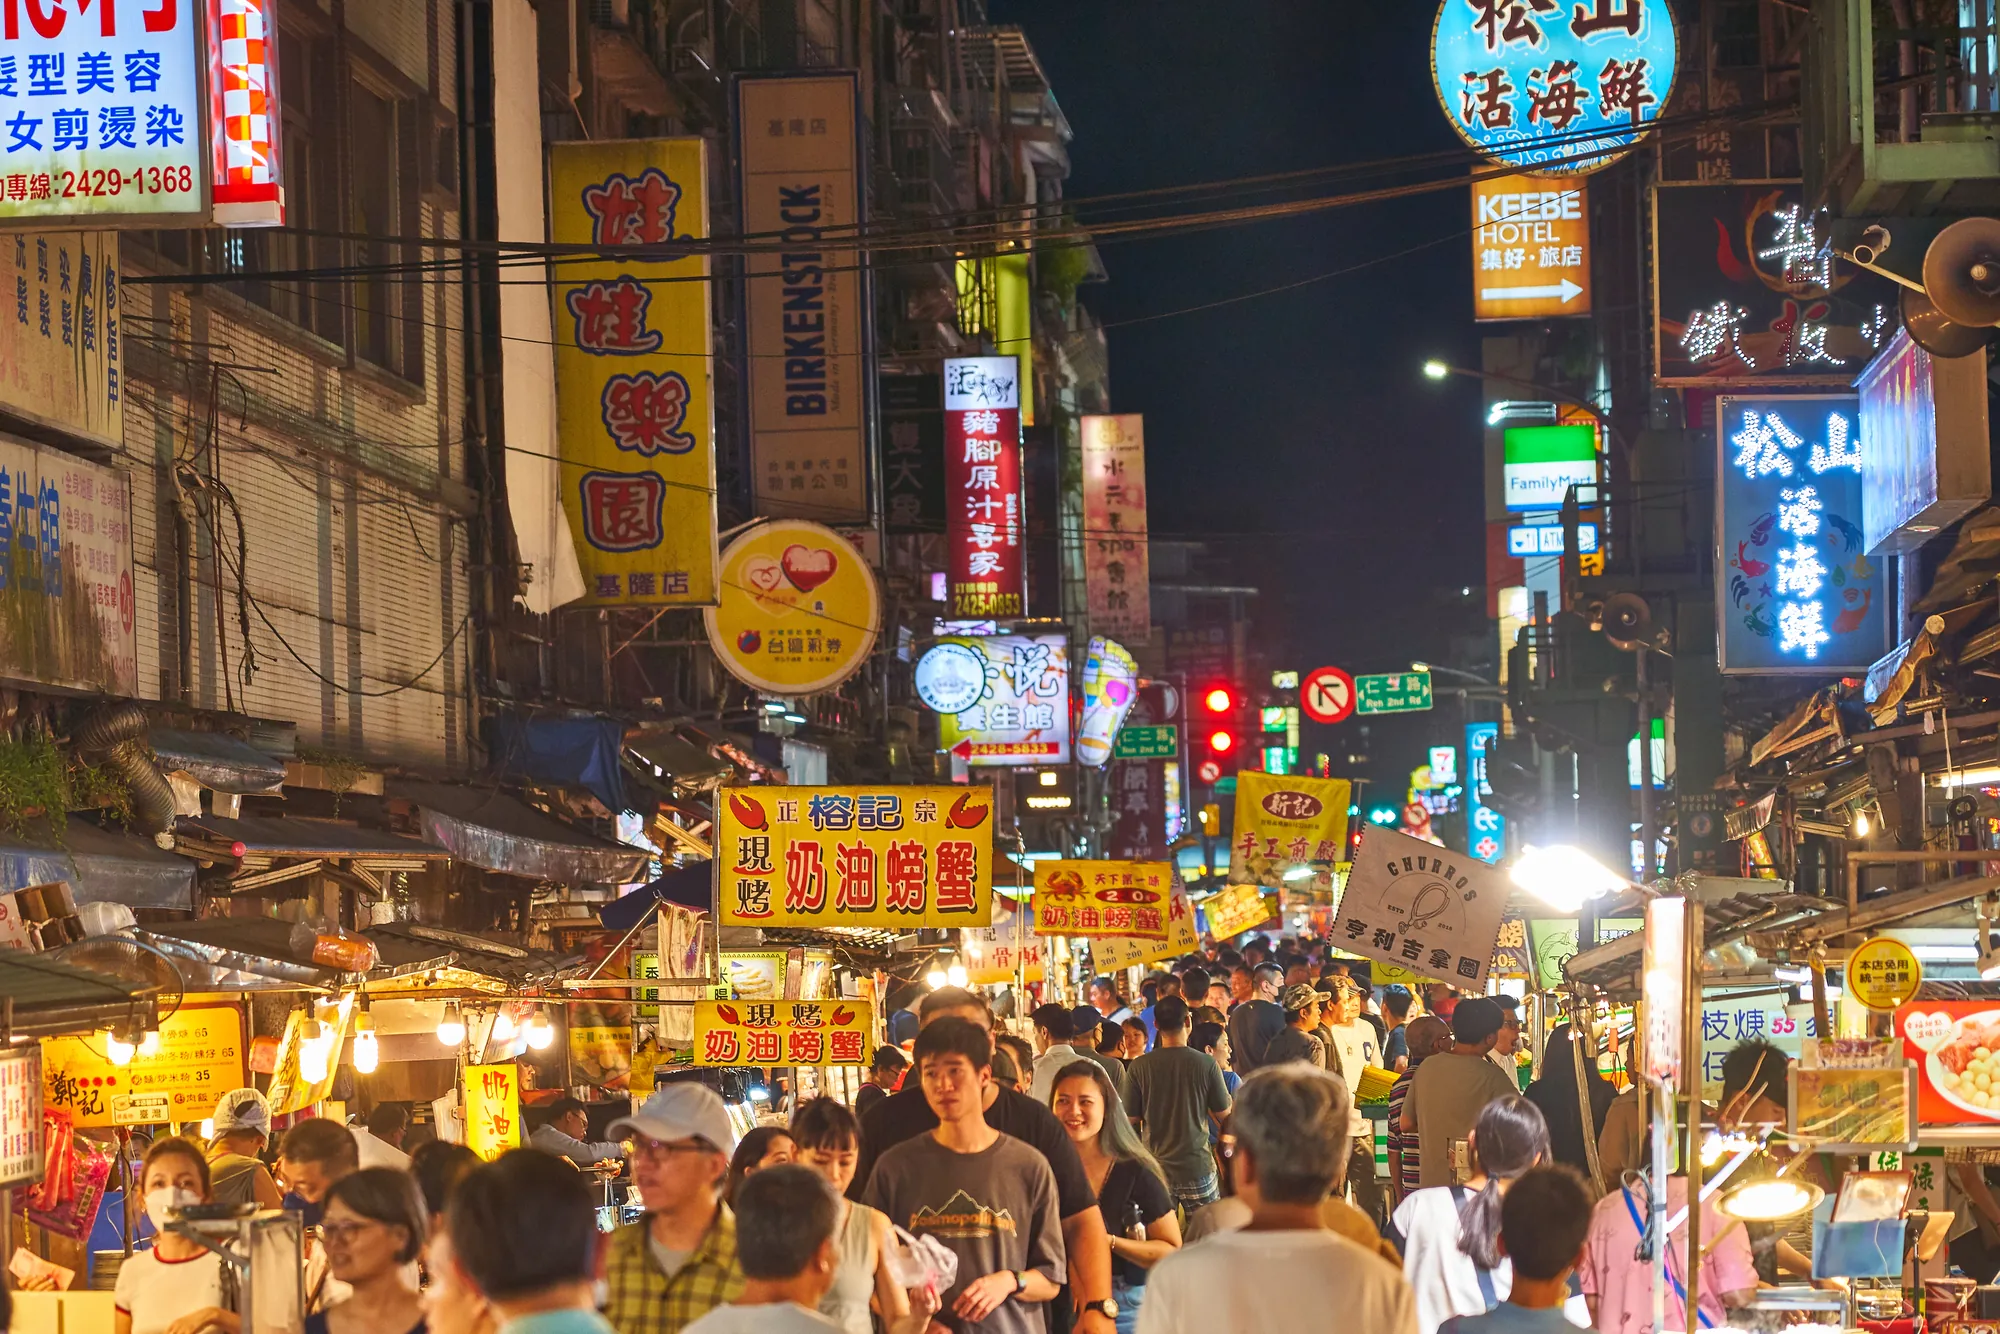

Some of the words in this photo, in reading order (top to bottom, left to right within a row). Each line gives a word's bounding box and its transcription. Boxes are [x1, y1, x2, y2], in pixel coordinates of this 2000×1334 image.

[1467, 0, 1643, 50] 松山
[1462, 57, 1656, 131] 活海鮮
[5, 104, 184, 154] 女剪燙染
[0, 164, 193, 201] 專線:2429-1368
[1478, 190, 1582, 223] KEEBE
[1479, 221, 1560, 245] HOTEL
[779, 184, 827, 415] BIRKENSTOCK
[1731, 409, 1862, 479] 松山
[1510, 474, 1593, 493] FamilyMart
[1543, 533, 1564, 548] ATM
[596, 571, 689, 598] 基隆店
[1777, 485, 1831, 660] 活海鮮
[956, 702, 1054, 732] 養生館
[808, 793, 903, 831] 榕記
[1267, 793, 1316, 817] 新記
[1236, 831, 1338, 863] 手工煎餃
[735, 836, 774, 916] 現烤
[784, 839, 980, 916] 奶油螃蟹
[1095, 873, 1160, 887] 天下第一味
[1386, 856, 1478, 902] CHURROS
[1041, 905, 1163, 931] 奶油螃蟹
[1151, 942, 1169, 954] 150
[1178, 936, 1194, 947] 100
[1100, 956, 1118, 967] 300
[1125, 949, 1143, 961] 200
[1859, 959, 1909, 972] 本店免用
[1859, 971, 1910, 984] 統一發票
[745, 1003, 824, 1028] 現烤
[1771, 1017, 1797, 1035] 55
[194, 1027, 208, 1038] 65
[703, 1028, 870, 1063] 奶油螃蟹
[222, 1047, 234, 1058] 65
[195, 1069, 211, 1082] 35
[50, 1070, 104, 1117] 鄭記
